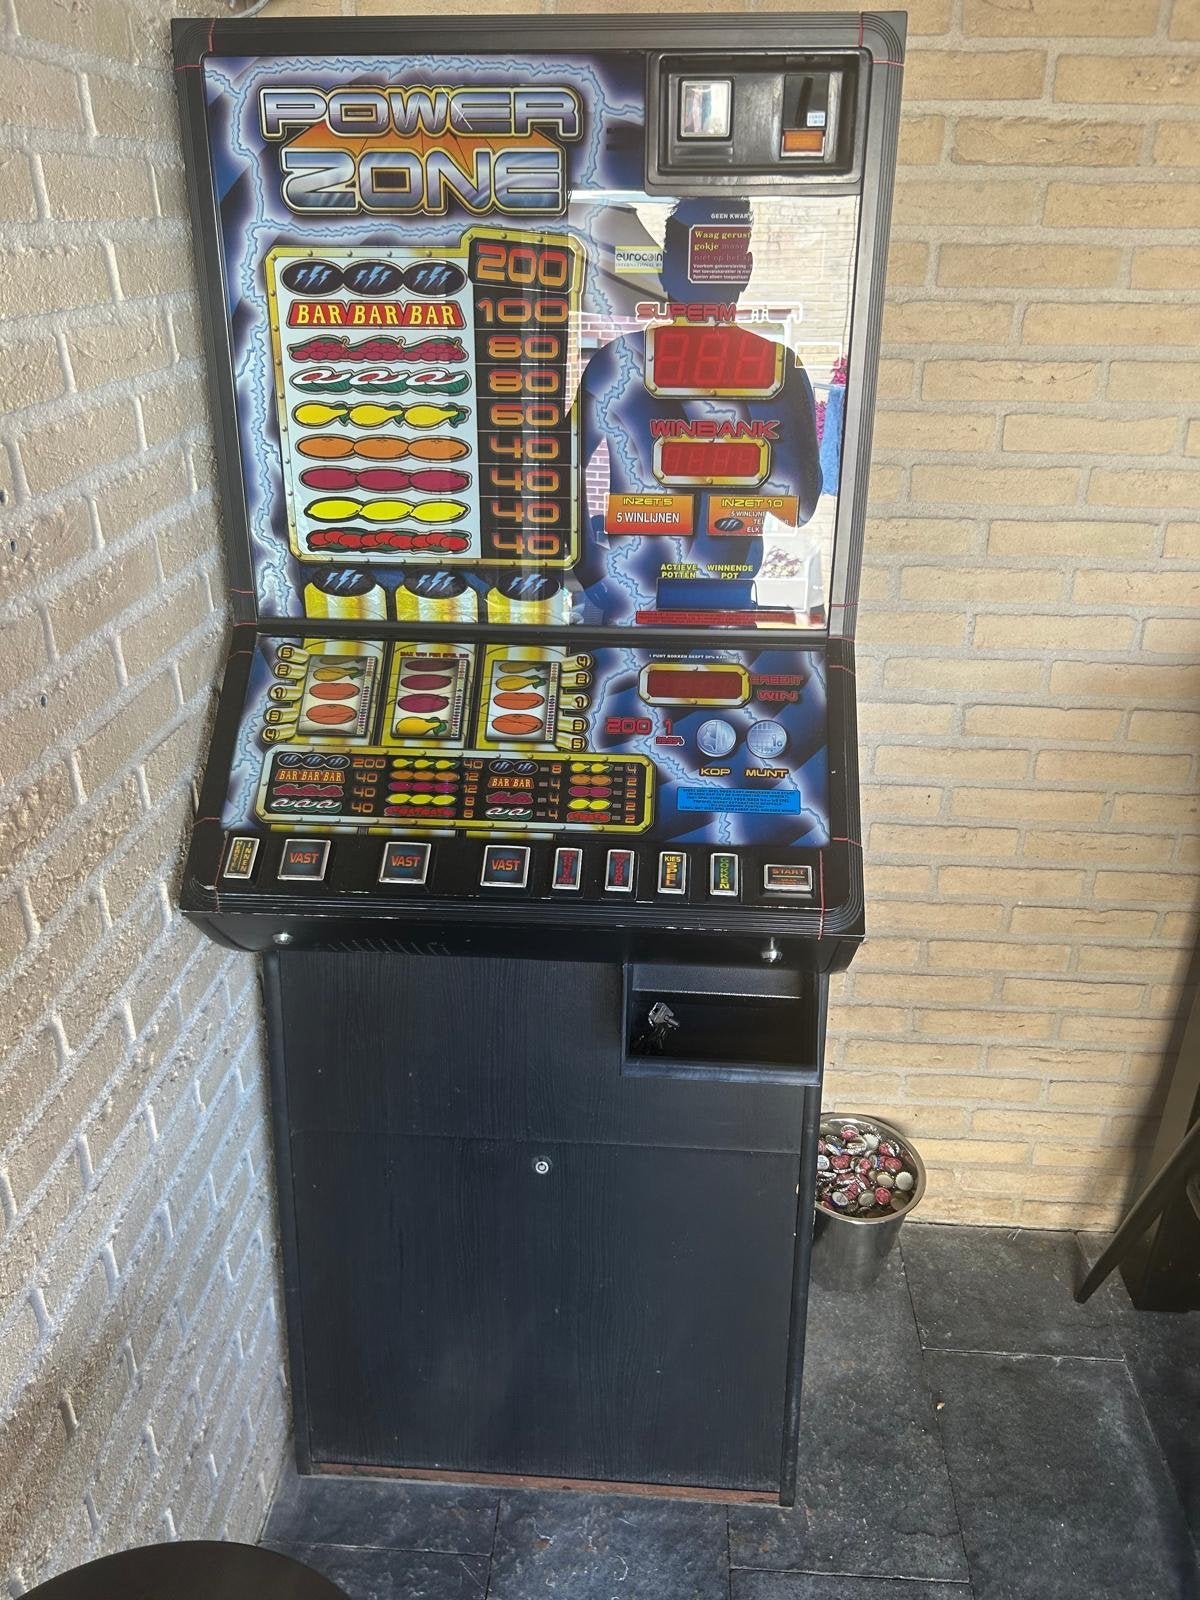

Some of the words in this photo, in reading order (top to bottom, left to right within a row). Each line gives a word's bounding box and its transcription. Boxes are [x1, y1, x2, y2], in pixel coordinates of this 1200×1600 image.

[259, 86, 582, 141] POWER
[281, 147, 566, 215] ZONE
[694, 231, 719, 239] Waag
[694, 242, 719, 251] gokje
[616, 253, 662, 261] eurocoin
[475, 244, 567, 287] 200
[296, 304, 342, 324] BAR
[353, 305, 398, 325] BAR
[410, 305, 456, 326] BAR
[477, 299, 567, 323] 100
[488, 336, 559, 359] 80
[489, 370, 559, 392] 80
[491, 404, 559, 427] 60
[651, 418, 780, 440] WINBANK
[489, 436, 559, 459] 40
[491, 469, 560, 492] 40
[721, 499, 763, 507] INZET
[767, 499, 783, 507] 10
[492, 501, 560, 524] 40
[616, 512, 622, 523] 5
[624, 512, 680, 523] WINLIJNEN
[493, 533, 560, 556] 40
[660, 563, 697, 571] ACTIEVE
[706, 564, 754, 572] WINNENDE
[661, 571, 697, 579] POTTEN
[757, 690, 799, 702] WIN
[607, 717, 652, 735] 200
[352, 758, 386, 768] 200
[463, 760, 483, 769] 40
[279, 771, 298, 780] BAR
[301, 771, 320, 781] BAR
[323, 772, 342, 782] BAR
[356, 773, 378, 783] 40
[700, 767, 731, 776] KOP
[745, 769, 789, 778] MUNT
[492, 778, 510, 787] BAR
[513, 779, 531, 788] BAR
[353, 787, 376, 797] 40
[351, 802, 374, 813] 40
[289, 853, 319, 864] VAST
[390, 855, 421, 867] VAST
[491, 859, 521, 871] VAST
